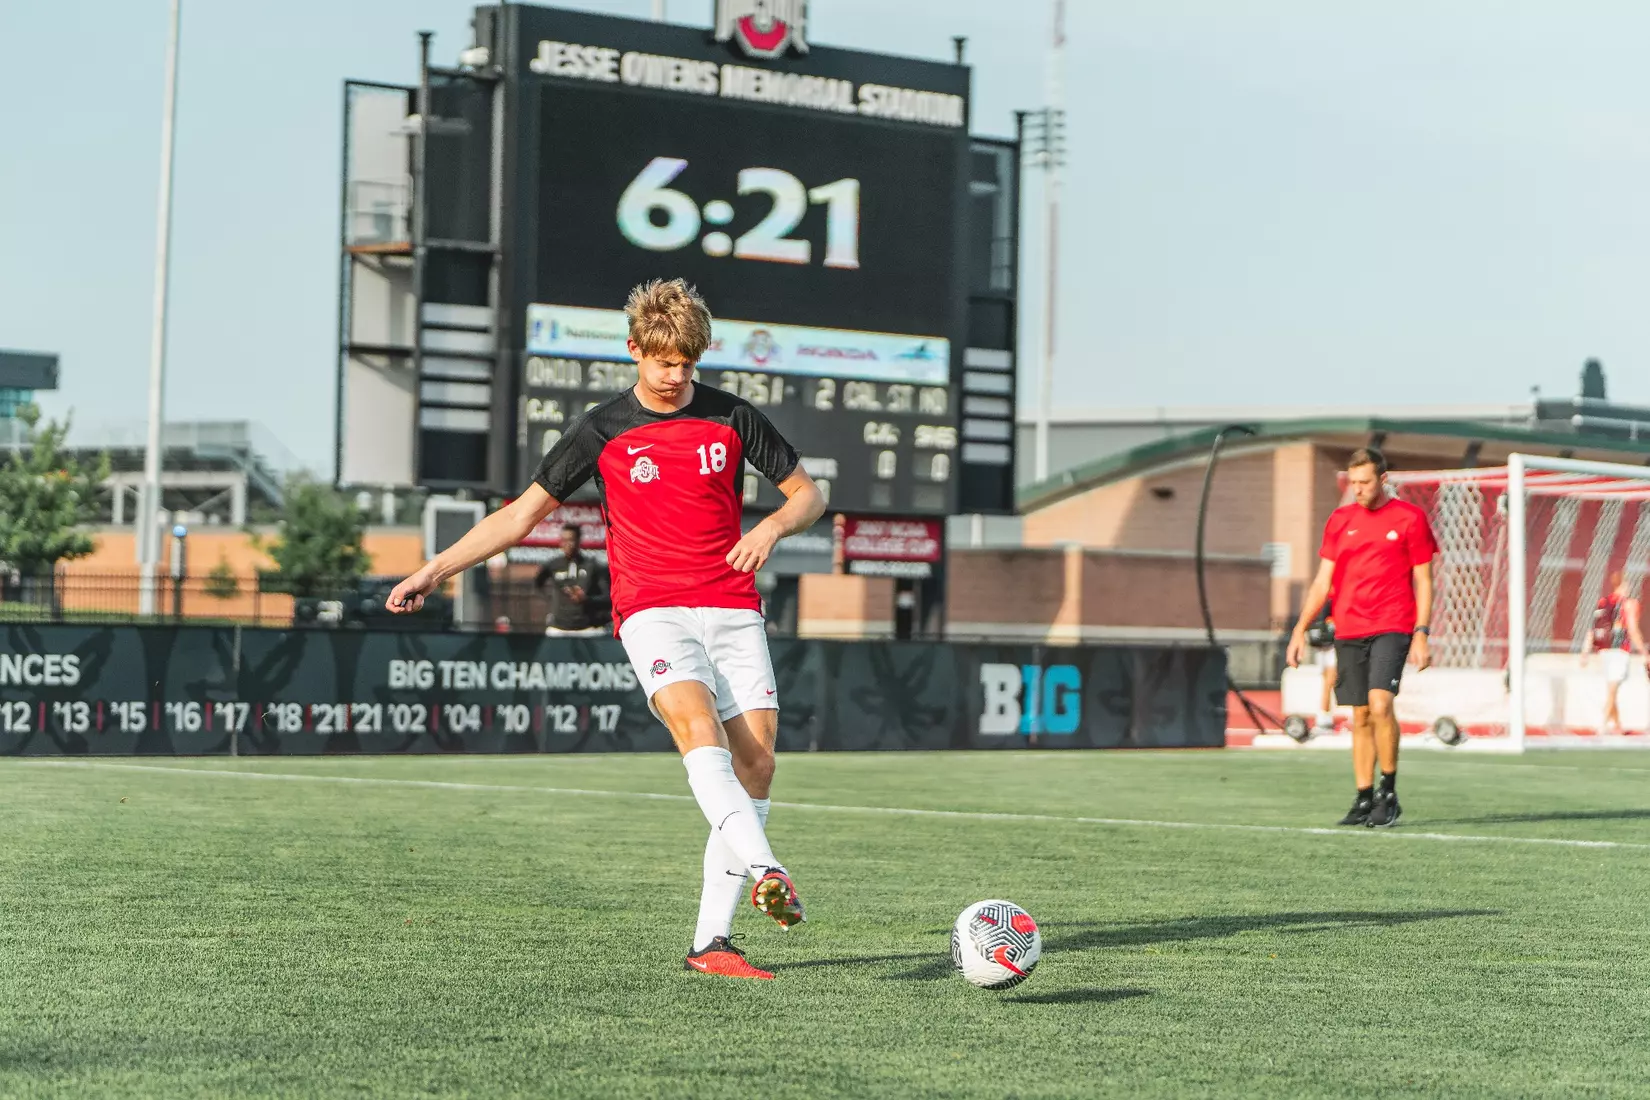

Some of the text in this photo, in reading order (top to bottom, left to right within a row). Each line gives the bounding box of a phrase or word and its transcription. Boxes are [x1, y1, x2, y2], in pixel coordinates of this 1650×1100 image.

[530, 40, 964, 127] JESSE OWENS MEMORIAL STADIUM
[616, 156, 860, 269] 6:21
[697, 442, 727, 475] 18
[0, 653, 81, 686] NCES
[388, 659, 637, 691] BIG TEN CHAMPIONS
[0, 701, 383, 733] 12 '13 '15 '16 '17 '18 '21 '21
[387, 703, 622, 734] '02 '04 '10 '12 '17
